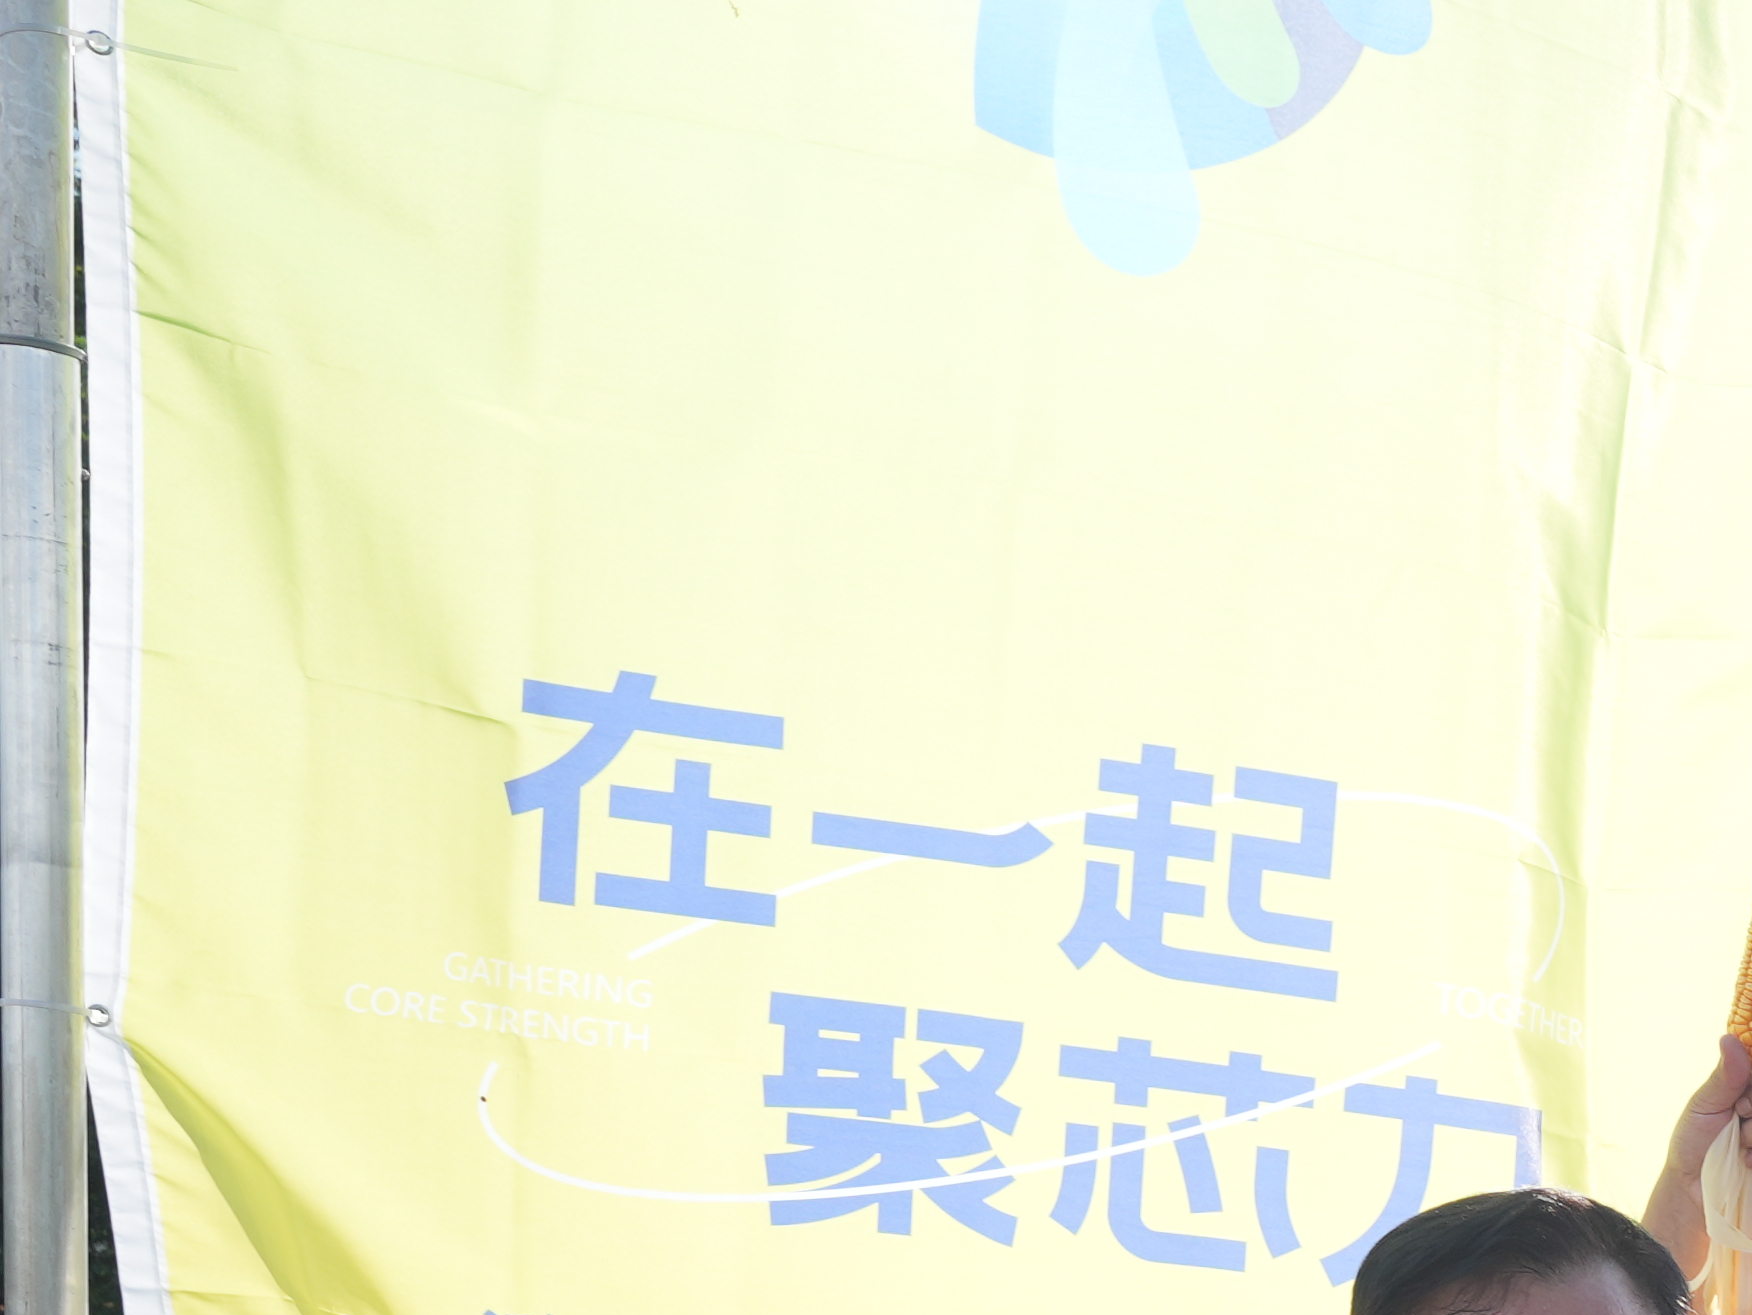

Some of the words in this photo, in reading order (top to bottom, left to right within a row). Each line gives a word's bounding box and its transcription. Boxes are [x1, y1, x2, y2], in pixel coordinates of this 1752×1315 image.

[503, 669, 1338, 1002] 在一起
[443, 952, 653, 1008] GATHERING
[1434, 981, 1584, 1048] TOGETHER
[344, 982, 445, 1025] CORE
[457, 1000, 651, 1052] STRENGTH
[762, 990, 1542, 1288] 聚芯力
